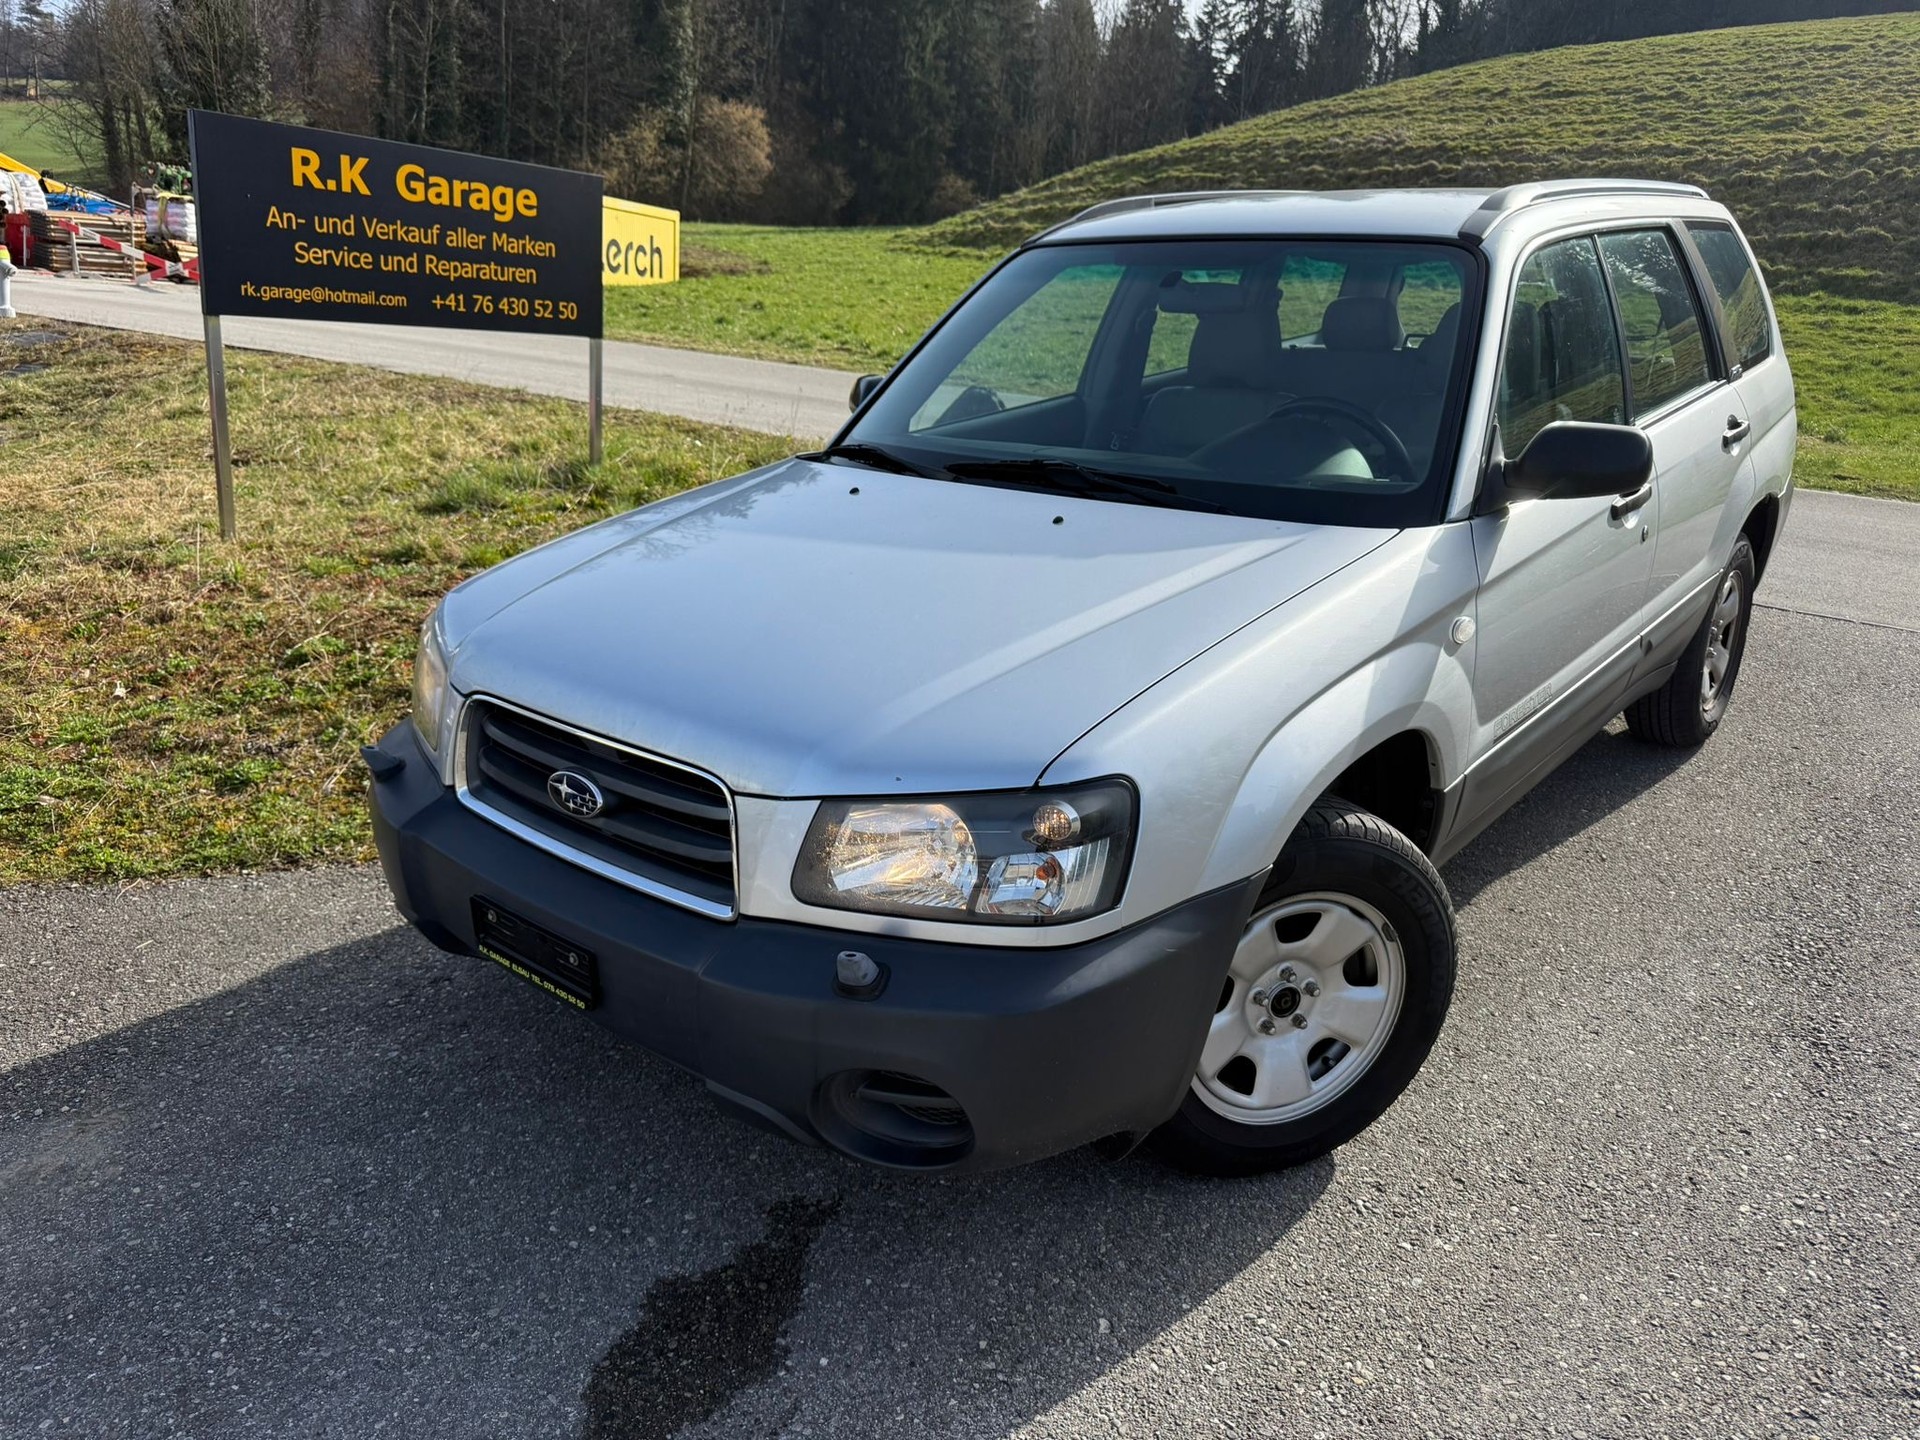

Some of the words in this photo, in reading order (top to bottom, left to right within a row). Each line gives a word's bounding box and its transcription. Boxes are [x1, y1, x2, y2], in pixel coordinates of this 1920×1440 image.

[290, 146, 373, 197] R.K
[395, 163, 539, 224] Garage
[266, 205, 306, 230] An-
[314, 214, 356, 237] und
[362, 217, 441, 246] Verkauf
[445, 226, 487, 251] aller
[491, 231, 557, 259] Marken
[602, 234, 663, 279] erch
[294, 241, 374, 271] Service
[380, 252, 419, 275] und
[424, 254, 538, 284] Reparaturen
[240, 282, 408, 308] rk.garage@hotmail.com
[432, 293, 466, 313] +41
[472, 294, 495, 315] 76
[498, 297, 530, 318] 430
[533, 299, 554, 320] 52
[558, 301, 579, 321] 50
[1492, 681, 1553, 739] FORESTER
